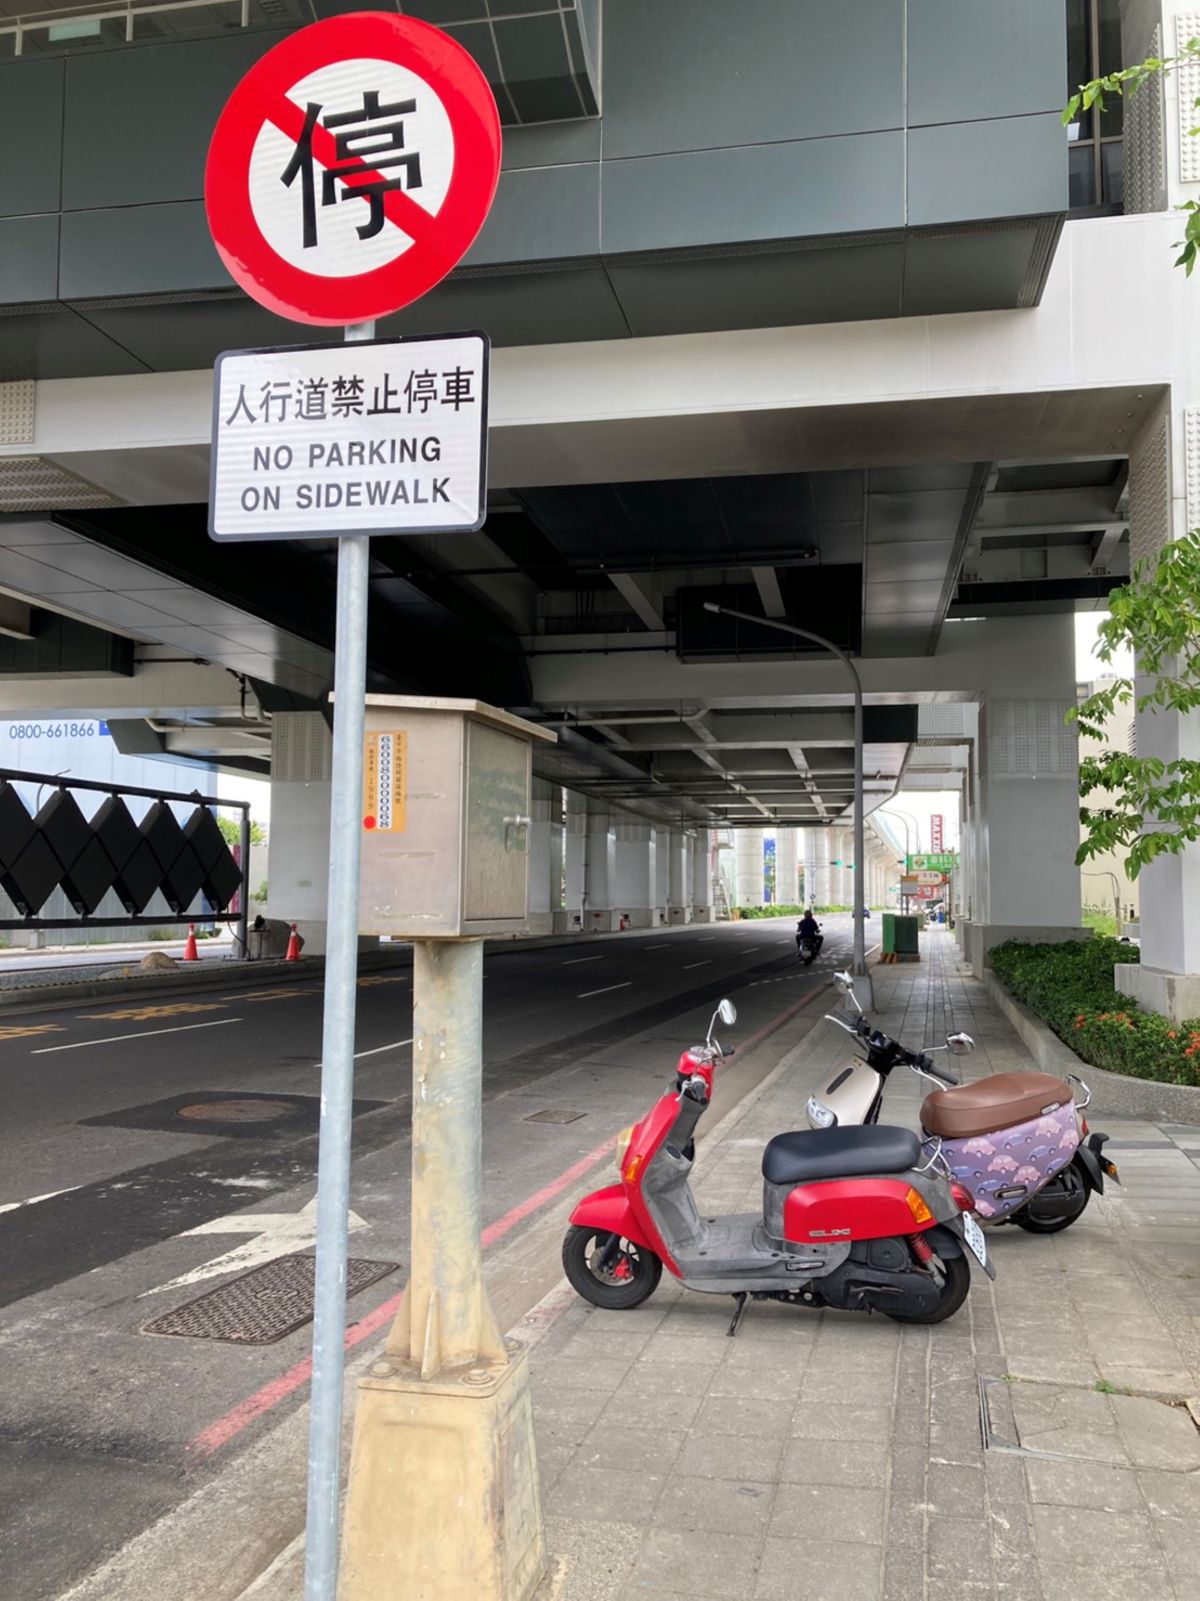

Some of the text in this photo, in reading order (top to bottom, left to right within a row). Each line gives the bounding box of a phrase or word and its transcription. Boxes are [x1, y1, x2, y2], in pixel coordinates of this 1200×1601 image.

[280, 90, 423, 248] 停
[225, 365, 475, 425] 人行道禁止停車
[253, 436, 441, 471] NO PARKING
[241, 477, 451, 512] ON SIDEWALK
[9, 723, 95, 739] 0800-661866
